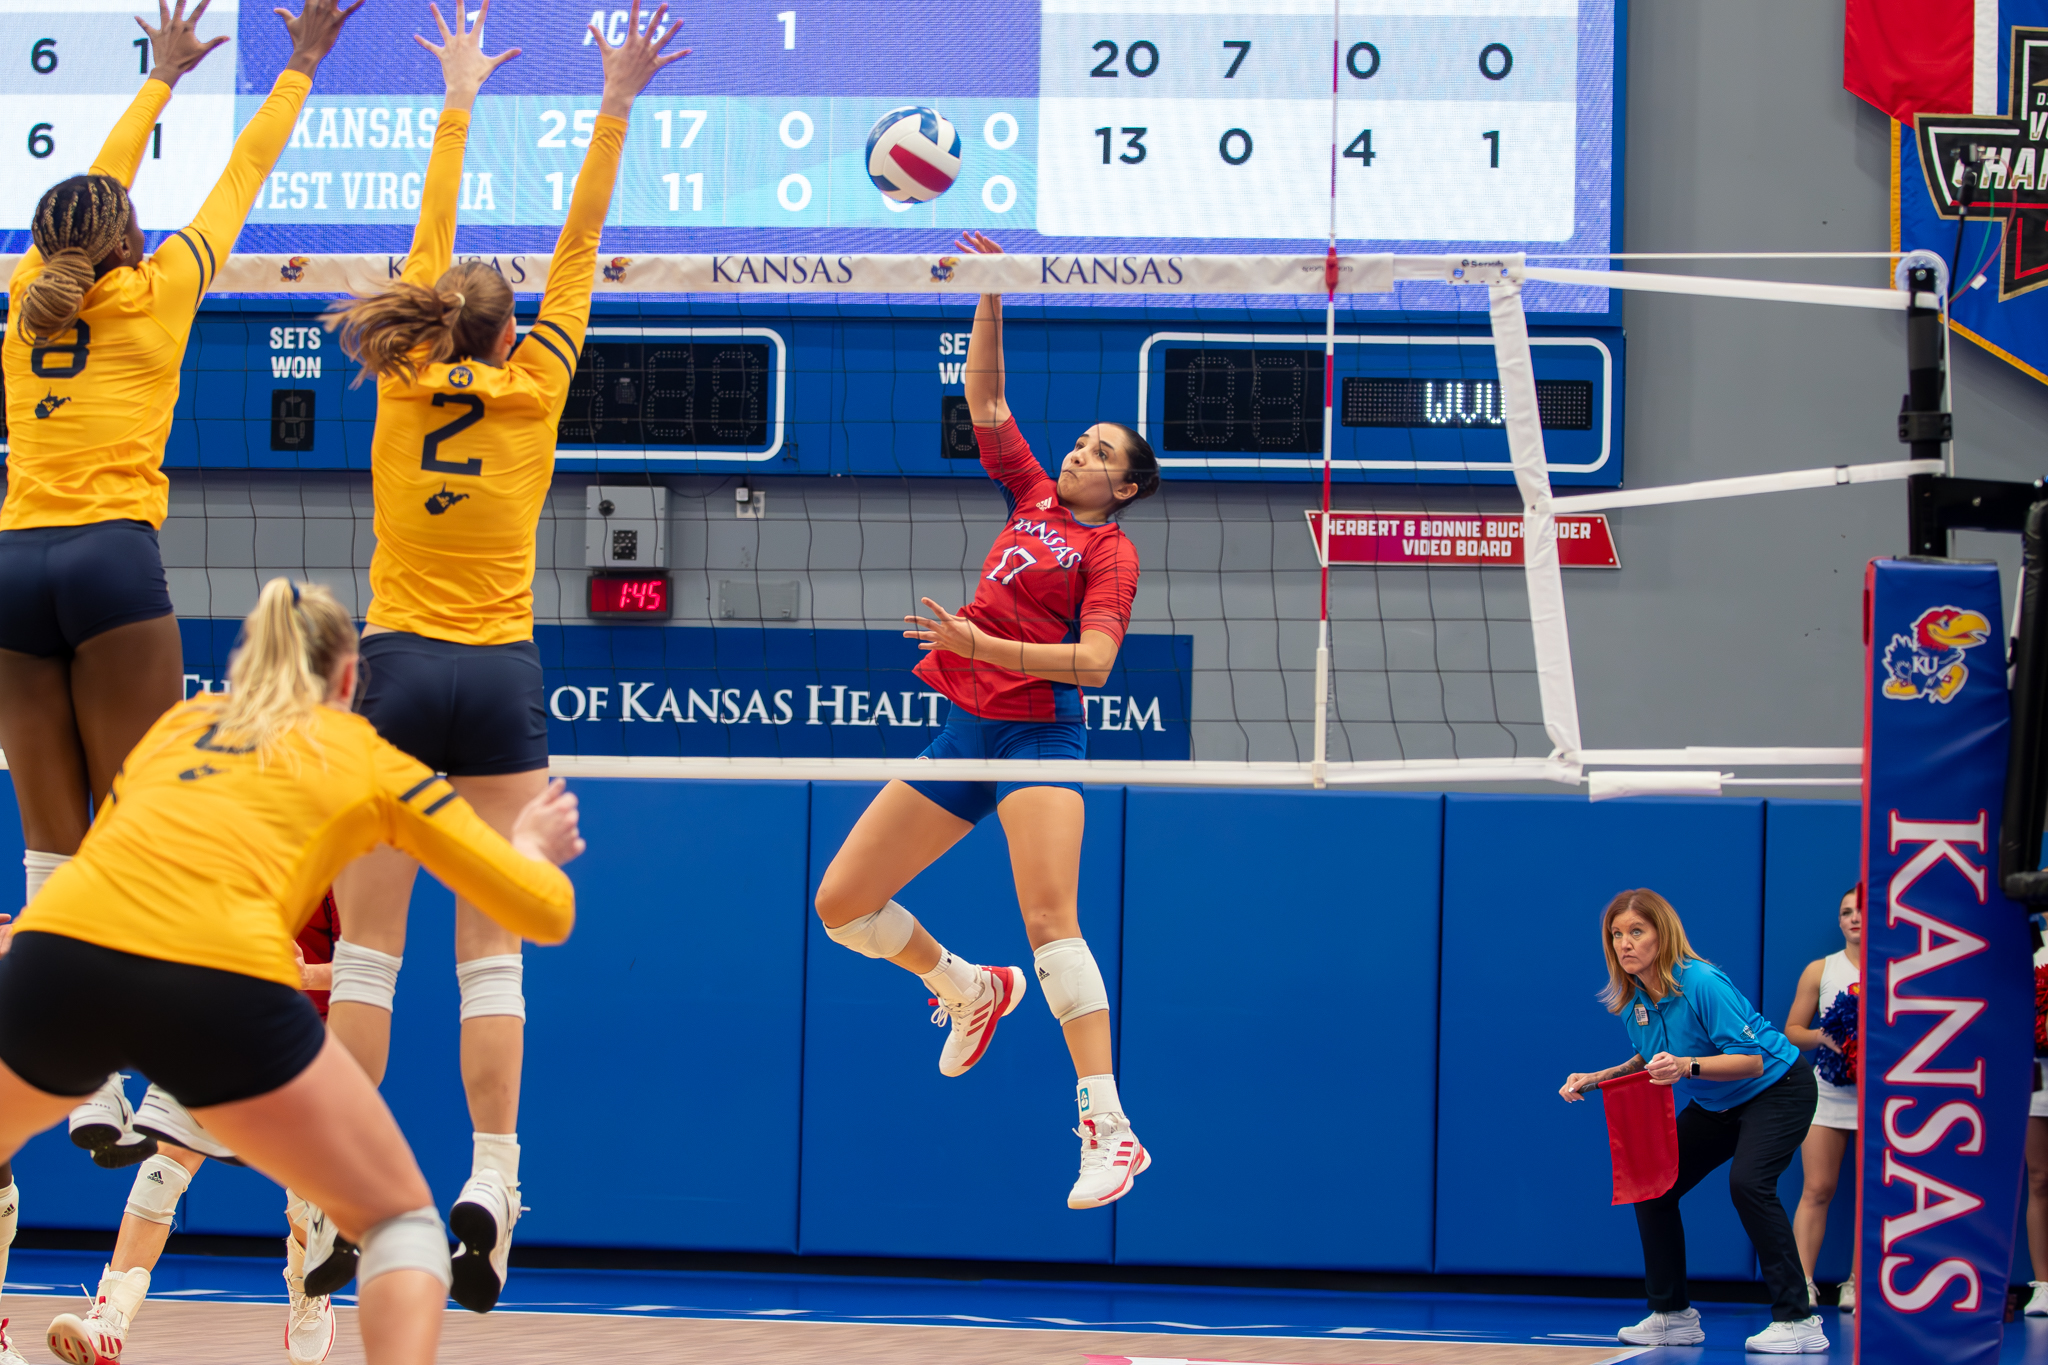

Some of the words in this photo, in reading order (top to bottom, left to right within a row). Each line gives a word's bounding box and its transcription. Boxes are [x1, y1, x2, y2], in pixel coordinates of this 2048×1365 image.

[777, 12, 797, 50] 1
[31, 38, 58, 74] 6
[1090, 40, 1160, 78] 20
[1223, 41, 1252, 78] 7
[1346, 41, 1380, 79] 0
[1478, 43, 1513, 81] 0
[28, 123, 55, 158] 6
[290, 107, 439, 148] KANSAS
[538, 110, 598, 148] 25
[654, 110, 707, 148] 17
[779, 110, 814, 149] 0
[983, 112, 1018, 150] 0
[1095, 126, 1148, 165] 13
[1219, 127, 1253, 166] 0
[1343, 129, 1376, 167] 4
[1482, 130, 1500, 168] 1
[342, 172, 496, 210] VIRGIA
[545, 172, 577, 210] 1
[662, 173, 704, 211] 11
[777, 173, 812, 211] 0
[982, 175, 1017, 213] 0
[712, 256, 853, 284] KANSAS
[1040, 256, 1183, 285] KANSAS
[270, 327, 321, 350] SETS
[271, 356, 321, 380] WON
[1426, 382, 1506, 424] WVU
[421, 393, 484, 476] 2
[1329, 520, 1399, 537] HERBERT
[1404, 521, 1415, 537] &
[1421, 521, 1481, 538] BONNIE
[985, 545, 1038, 585] 17
[1402, 539, 1452, 556] VIDEO
[1456, 540, 1512, 557] BOARD
[619, 580, 663, 610] 1:45
[1911, 656, 1939, 677] KU
[550, 685, 609, 722] OF
[618, 682, 793, 725] KANSAS
[806, 685, 949, 727] HEALT
[1083, 695, 1166, 732] TEM
[1879, 808, 1989, 1314] KANSAS
